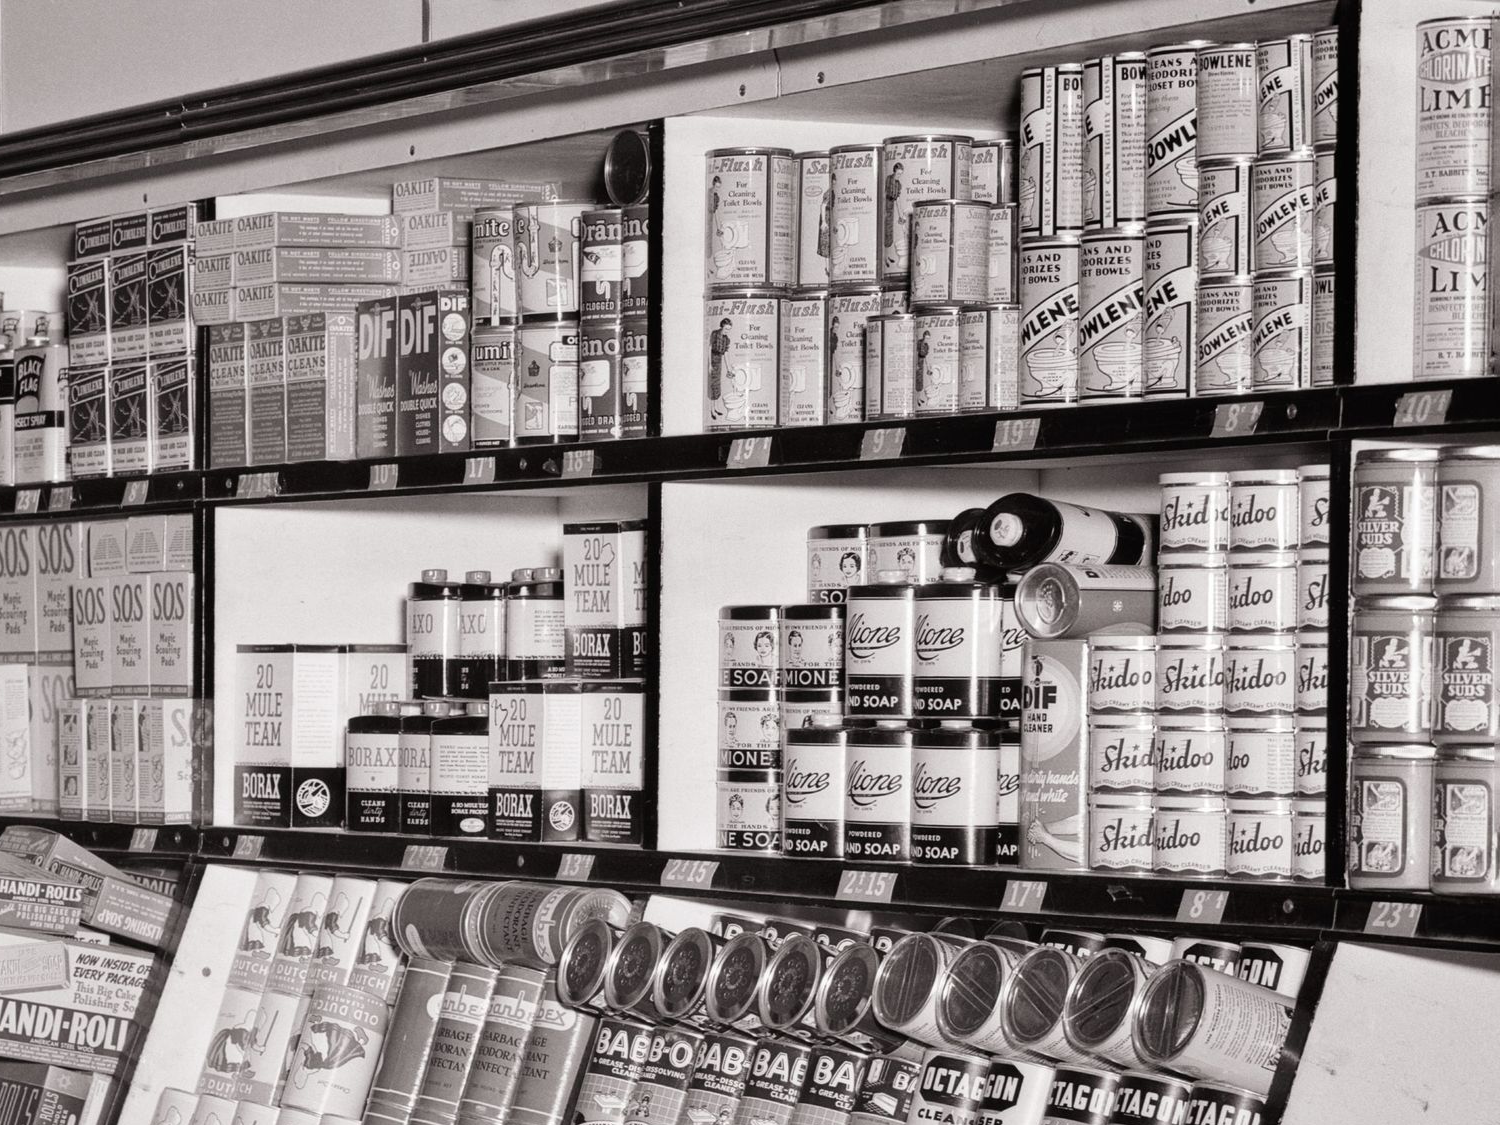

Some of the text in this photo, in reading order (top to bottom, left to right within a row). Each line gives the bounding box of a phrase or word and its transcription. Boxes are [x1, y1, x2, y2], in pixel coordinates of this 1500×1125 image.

[396, 180, 434, 197] OAKITE
[912, 177, 940, 186] Cleaning
[728, 191, 756, 199] Cleaning
[1256, 194, 1310, 236] BOWLENE
[198, 220, 233, 236] OAKITE
[238, 215, 273, 231] OAKITE
[1106, 245, 1132, 255] AND
[1037, 254, 1060, 262] AND
[1098, 267, 1131, 276] BOWLS
[1030, 275, 1060, 284] BOWLS
[585, 301, 614, 311] CLOGGED
[359, 312, 394, 359] DIF
[401, 305, 436, 355] DIF
[18, 362, 41, 377] BLACK
[288, 358, 325, 371] CLEANS
[212, 366, 244, 379] CLEANS
[19, 379, 39, 394] FLAG
[401, 397, 437, 412] DOUBLE QUICK
[1359, 521, 1399, 533] SILVER
[1361, 533, 1392, 545] SUDS
[3, 592, 22, 606] Magic
[575, 590, 610, 613] TEAM
[5, 623, 21, 634] Pads
[156, 645, 181, 658] Scouring
[573, 634, 610, 657] BORAX
[257, 664, 273, 688] 20
[1444, 672, 1492, 685] SILVER
[1448, 684, 1484, 696] SUDS
[246, 693, 282, 717] MULE
[864, 696, 898, 708] SOAP
[927, 699, 962, 710] SOAP
[604, 698, 621, 721] 20
[1027, 713, 1047, 722] HAND
[245, 722, 281, 746] TEAM
[593, 723, 632, 747] MULE
[1024, 724, 1053, 733] CLEANER
[592, 751, 631, 774] TEAM
[1047, 770, 1079, 784] hands
[243, 773, 281, 799] BORAX
[1039, 790, 1068, 802] white
[591, 794, 631, 818] BORAX
[18, 904, 32, 912] THE
[50, 908, 69, 916] CAKE
[17, 912, 57, 923] POLISHING
[76, 953, 98, 965] NOW
[101, 957, 135, 972] INSIDE
[74, 968, 104, 981] EVERY
[76, 982, 136, 1001] This Big Cake
[73, 994, 120, 1013] Polishing
[30, 1038, 57, 1046] AMERICAN
[77, 1045, 94, 1053] WOOL
